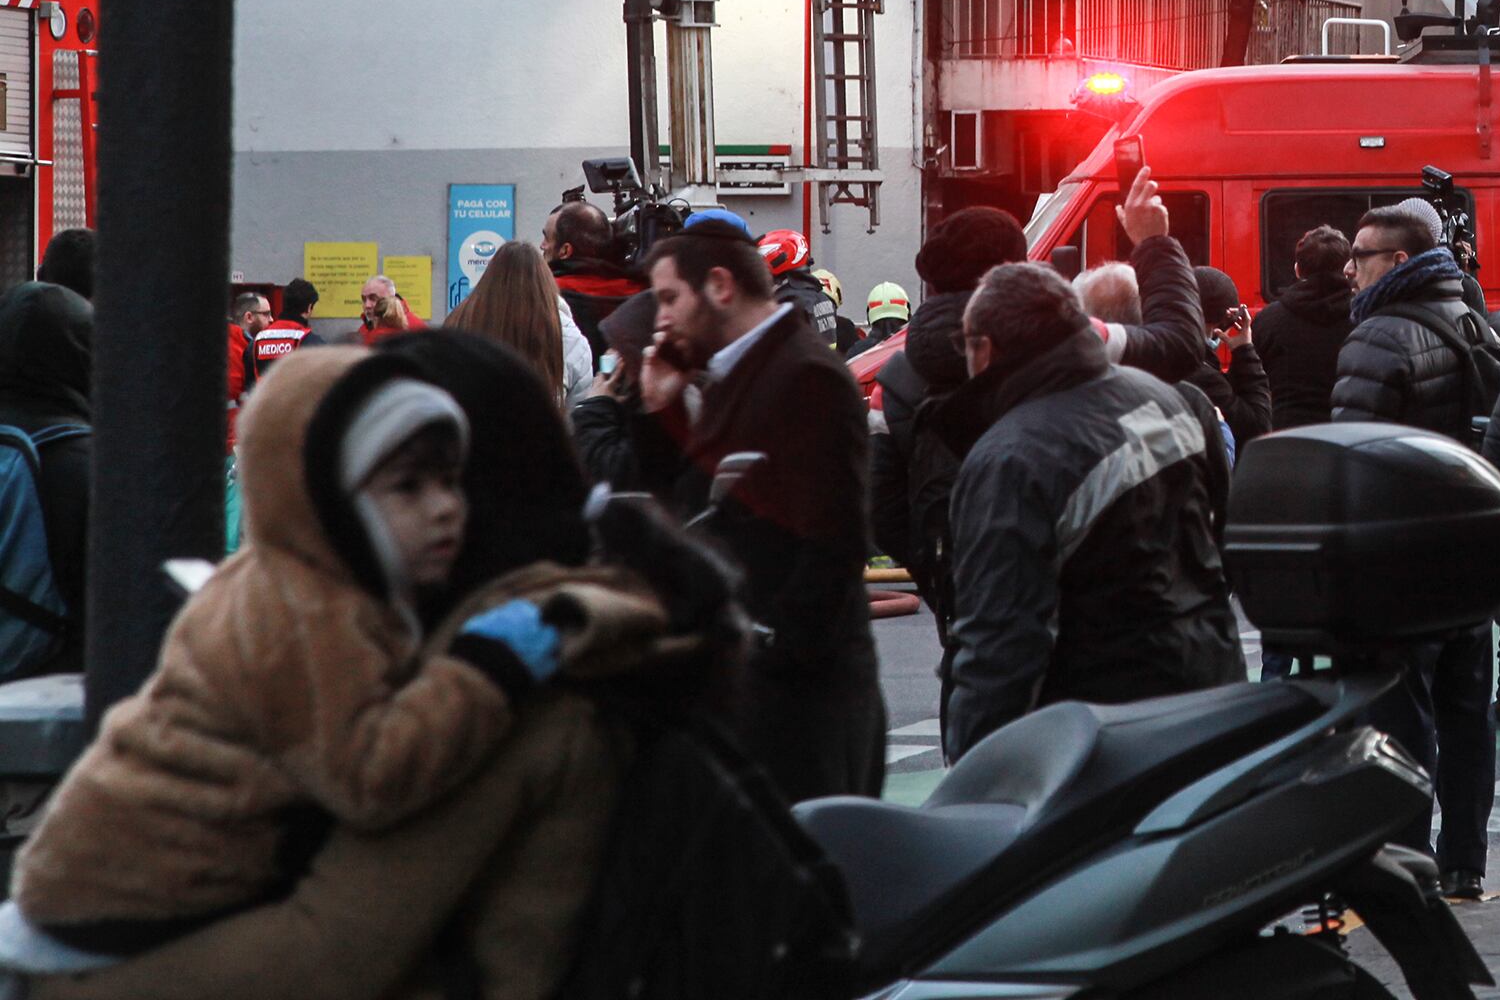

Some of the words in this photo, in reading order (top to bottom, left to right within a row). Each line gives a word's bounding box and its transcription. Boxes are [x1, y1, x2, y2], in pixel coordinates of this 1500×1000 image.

[485, 200, 507, 208] CON
[454, 210, 465, 218] TU
[467, 210, 512, 218] CELULAR
[258, 342, 292, 355] MEDICO
